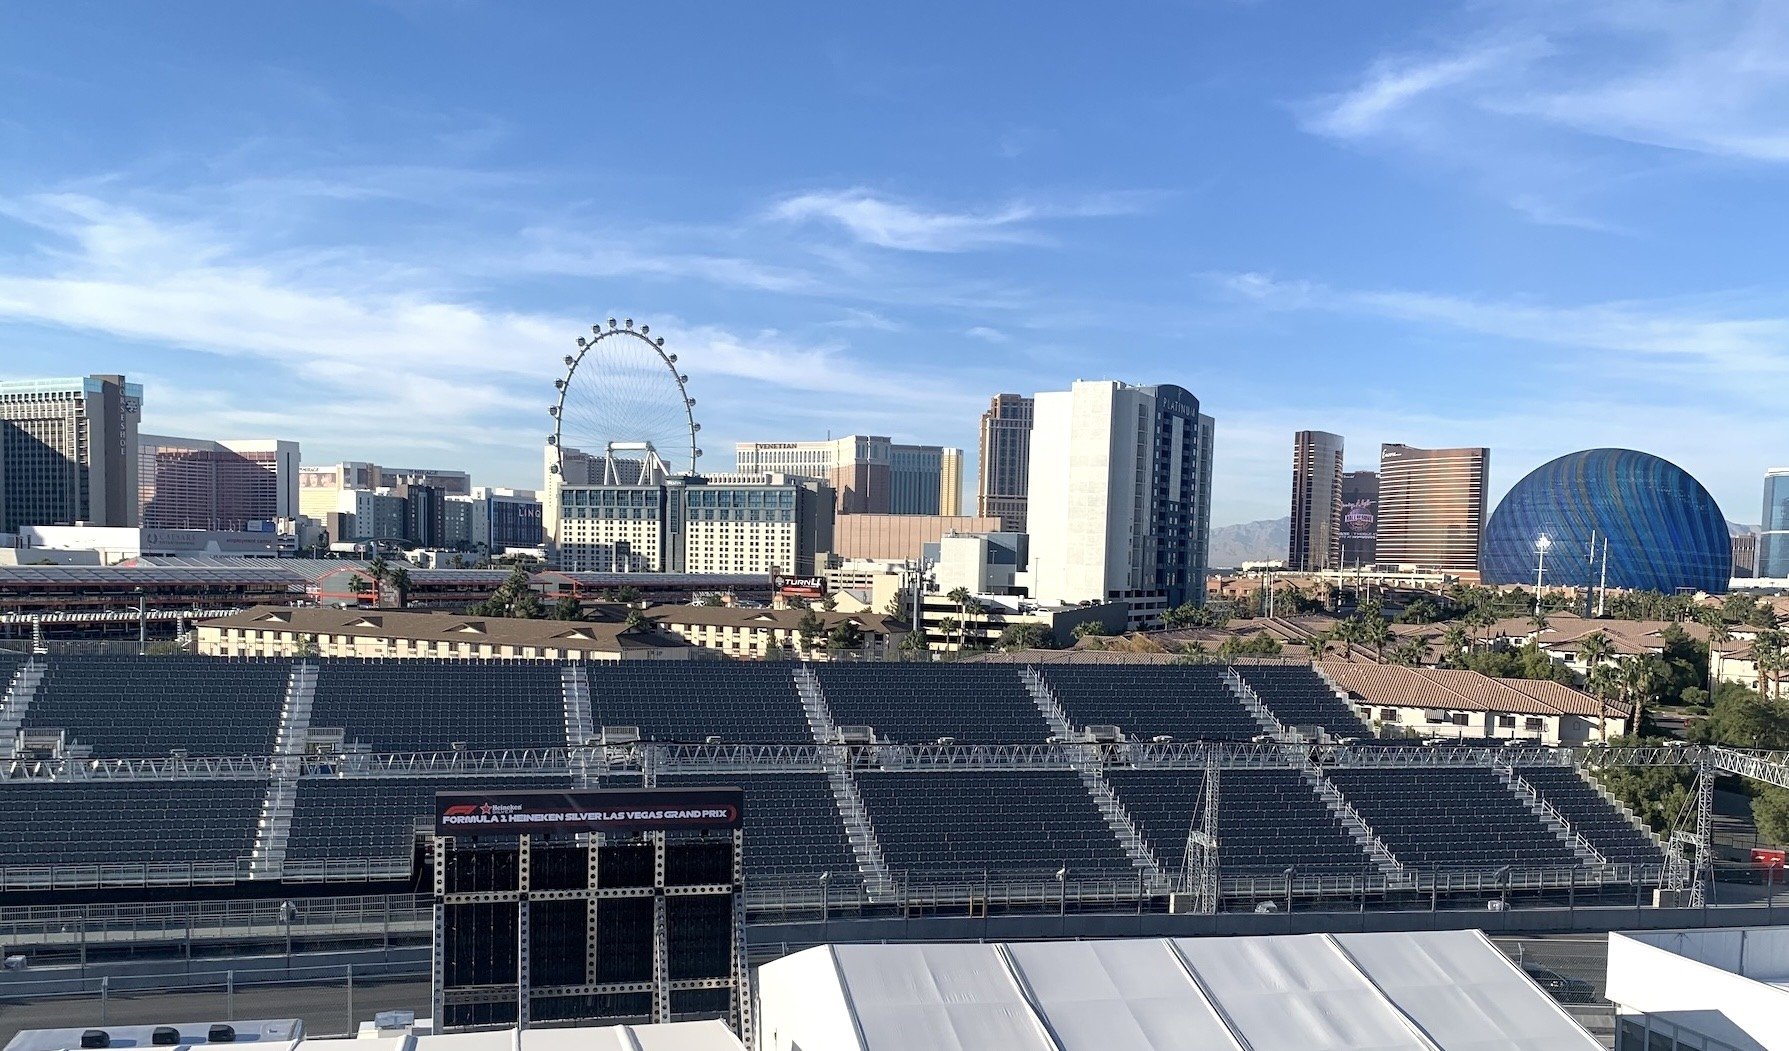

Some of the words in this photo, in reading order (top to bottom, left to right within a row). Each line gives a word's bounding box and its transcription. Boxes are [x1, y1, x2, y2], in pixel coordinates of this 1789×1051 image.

[519, 508, 541, 518] LINQ
[442, 814, 499, 824] FORMULA
[508, 813, 563, 822] HEINEKEN
[565, 812, 602, 821] SILVER
[603, 812, 625, 820] LAS
[626, 811, 663, 819] VEGAS
[664, 810, 701, 818] GRAND
[702, 809, 727, 818] PRIX
